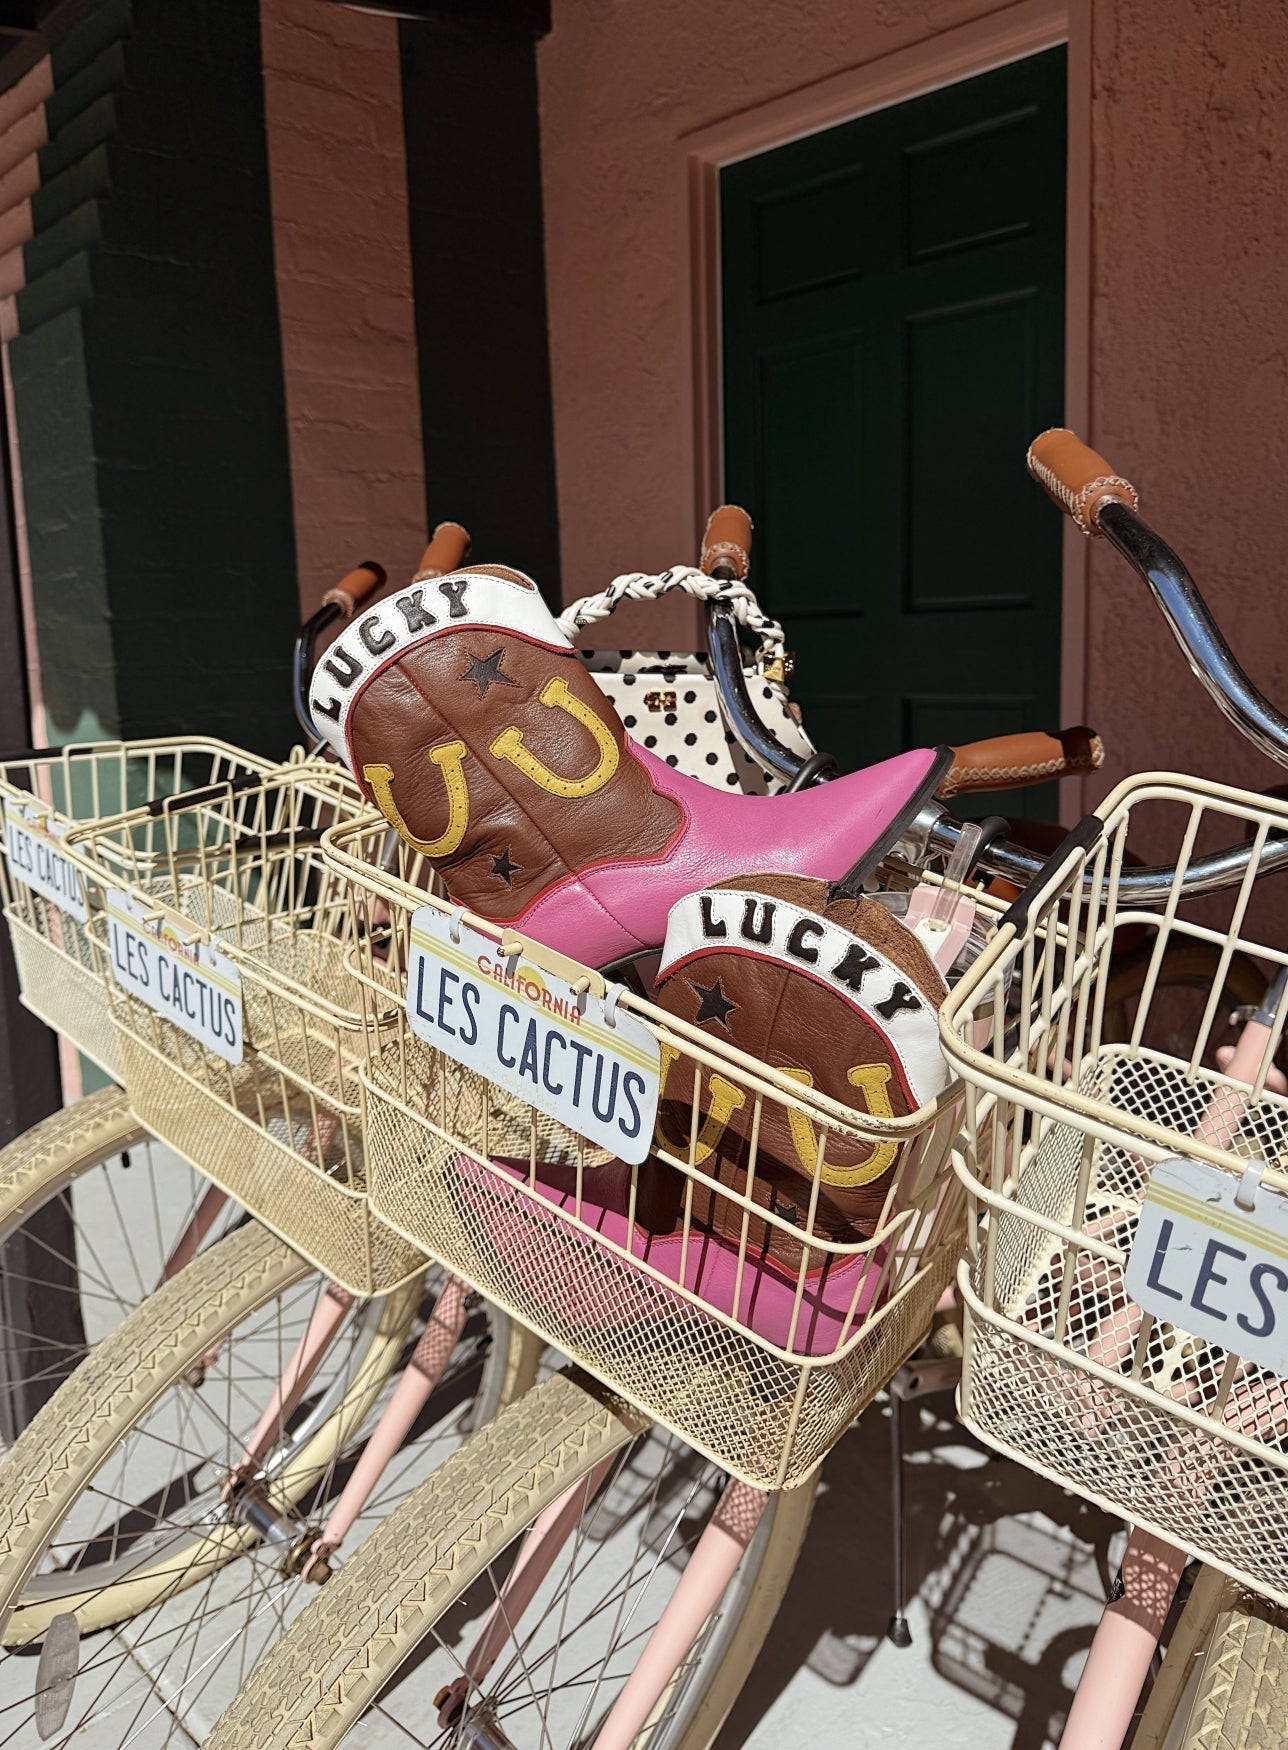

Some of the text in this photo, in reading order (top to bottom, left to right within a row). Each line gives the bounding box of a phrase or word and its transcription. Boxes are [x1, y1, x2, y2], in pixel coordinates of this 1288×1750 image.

[312, 580, 469, 723] LUCKY
[9, 825, 33, 872] LES
[113, 923, 236, 1047] LES CACTUS
[477, 955, 581, 1026] CALIFORNIA
[699, 896, 923, 1019] LUCKY
[416, 955, 646, 1139] LES CACTUS
[1146, 1218, 1288, 1338] LES
